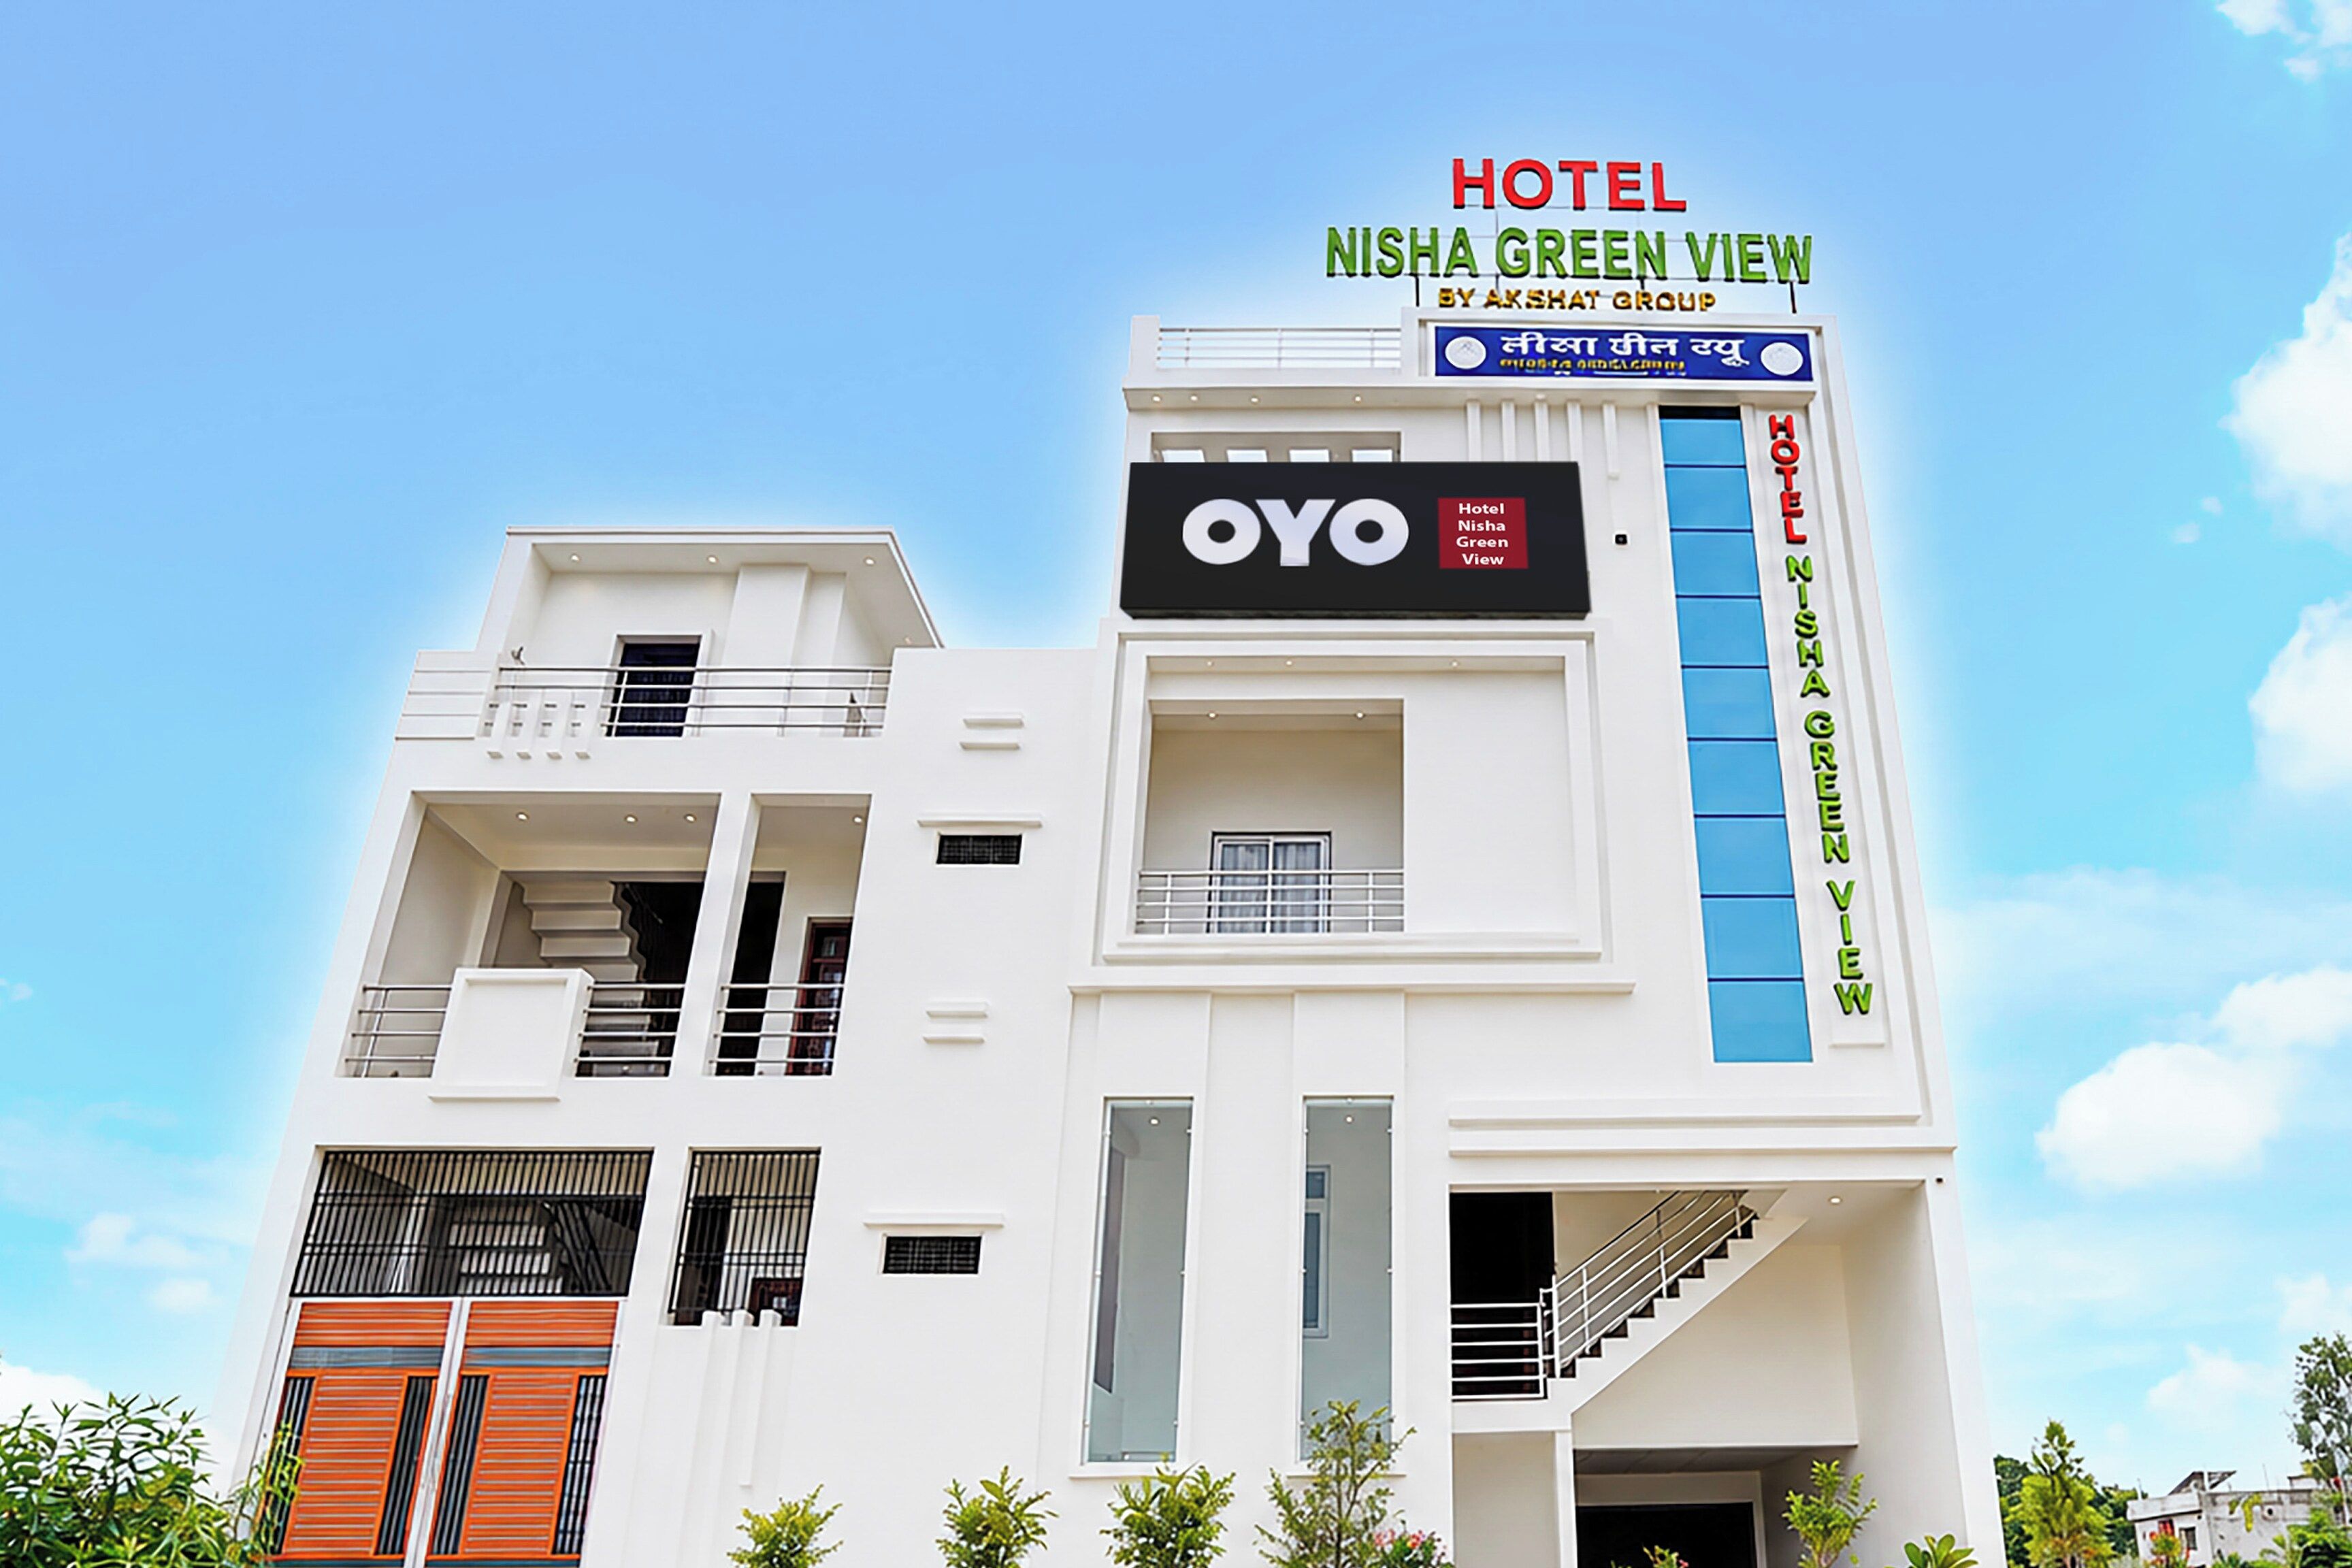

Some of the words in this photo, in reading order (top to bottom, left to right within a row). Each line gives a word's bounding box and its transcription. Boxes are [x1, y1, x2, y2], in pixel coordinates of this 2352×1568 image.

[1453, 158, 1687, 211] HOTEL
[1326, 227, 1480, 278] NISHA
[1495, 228, 1667, 281] GREEN
[1685, 232, 1812, 284] VIEW
[1438, 287, 1475, 308] BY
[1483, 289, 1601, 310] AKSHAT
[1612, 291, 1716, 312] GROUP
[1769, 414, 1807, 544] HOTEL
[1183, 498, 1409, 567] OYO
[1458, 502, 1505, 514] Hotel
[1458, 519, 1506, 532] Nisha
[1456, 536, 1509, 548] Green
[1462, 553, 1505, 565] View
[1786, 555, 1831, 698] NISHA
[1804, 710, 1851, 864] GREEN
[1825, 879, 1873, 1015] VIEW
